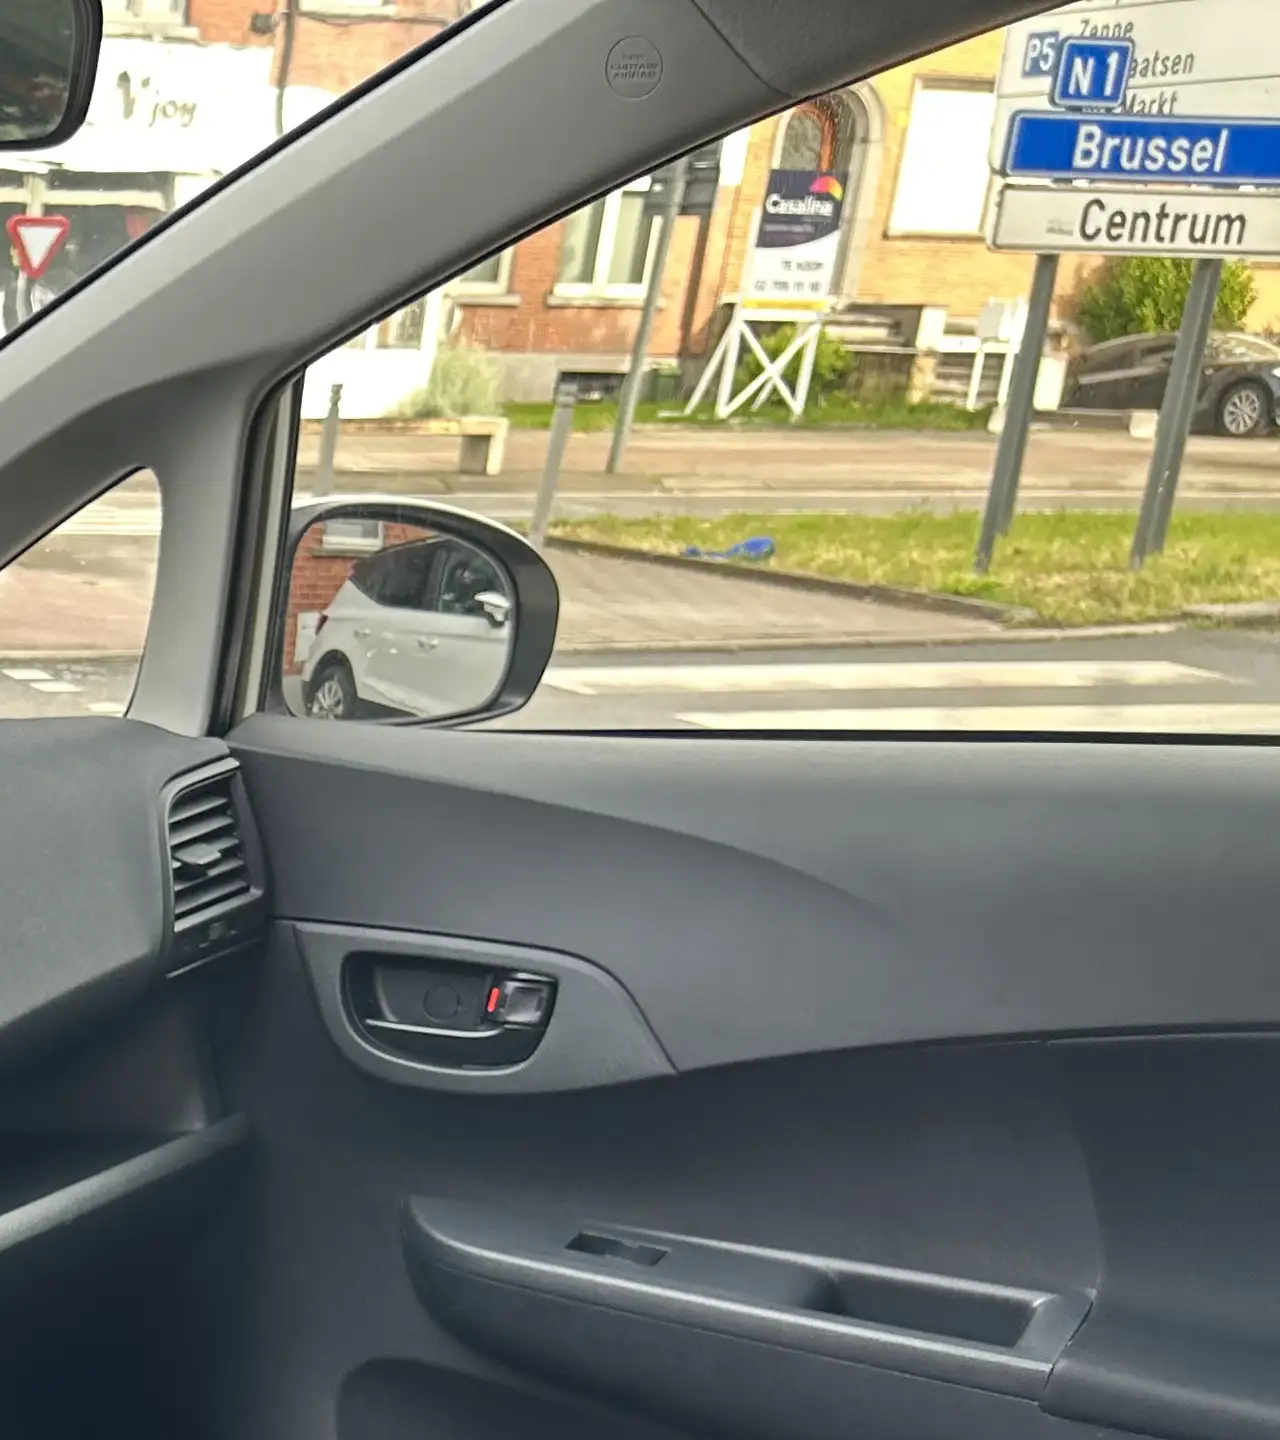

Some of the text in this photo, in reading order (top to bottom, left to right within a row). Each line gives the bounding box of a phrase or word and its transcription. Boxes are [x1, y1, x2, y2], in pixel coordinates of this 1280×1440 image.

[1025, 37, 1057, 72] P5
[1072, 123, 1228, 173] Brussel
[1079, 198, 1247, 247] Centrum
